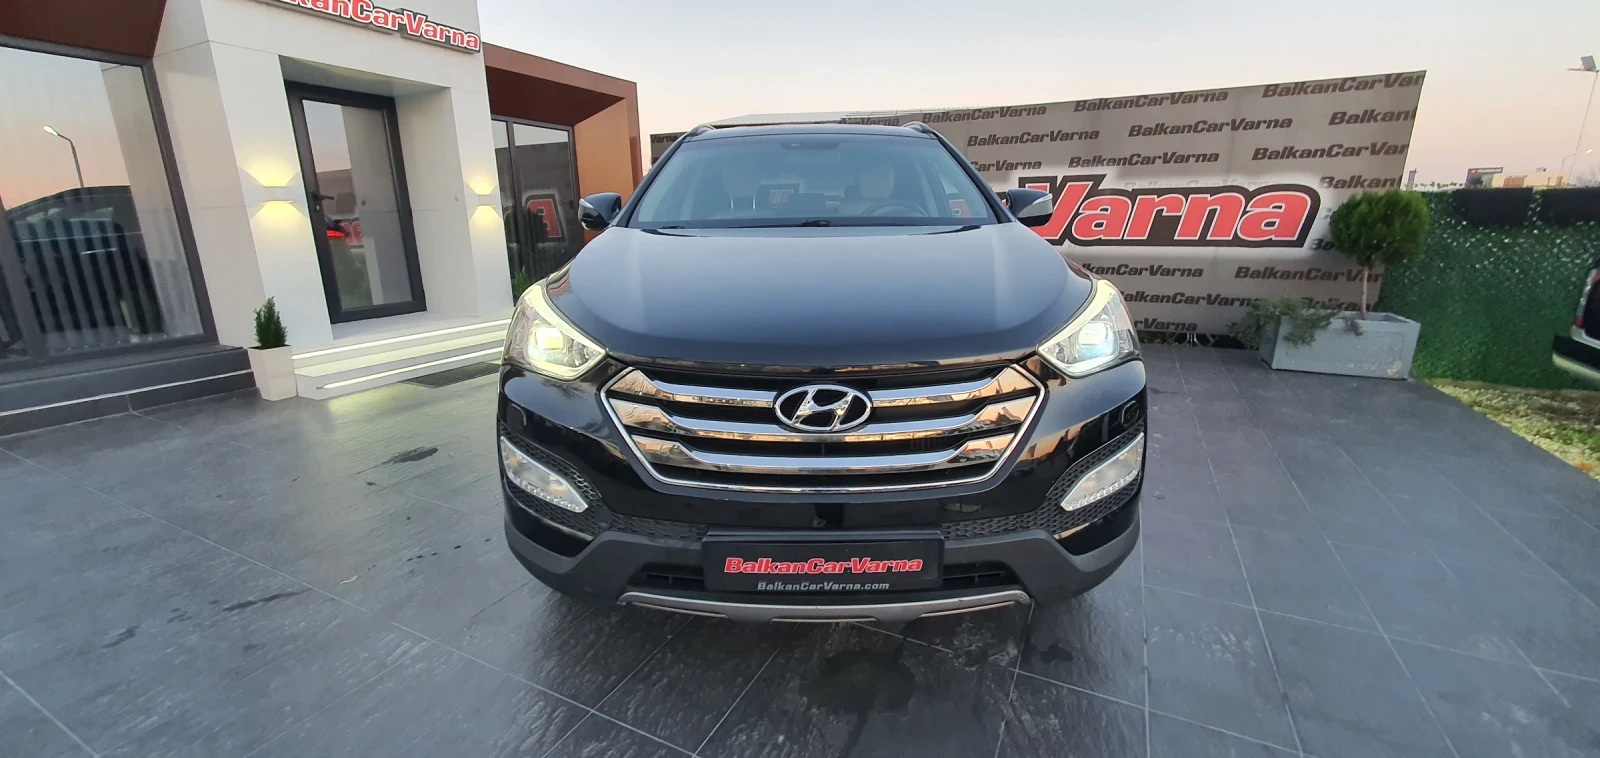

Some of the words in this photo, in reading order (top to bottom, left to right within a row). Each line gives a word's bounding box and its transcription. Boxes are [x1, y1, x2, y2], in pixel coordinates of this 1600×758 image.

[1073, 91, 1229, 112] BalkanCarVarna
[922, 106, 1047, 123] BalkanCarVarna
[1128, 118, 1293, 138] BalkanCarVarna
[967, 130, 1100, 147] BalkanCarVarna
[1068, 152, 1220, 168] BalkanCarVarna
[1016, 181, 1312, 241] Varna
[724, 557, 924, 574] BalkanCarVarna
[757, 581, 890, 591] BalkanCarVarna.com
